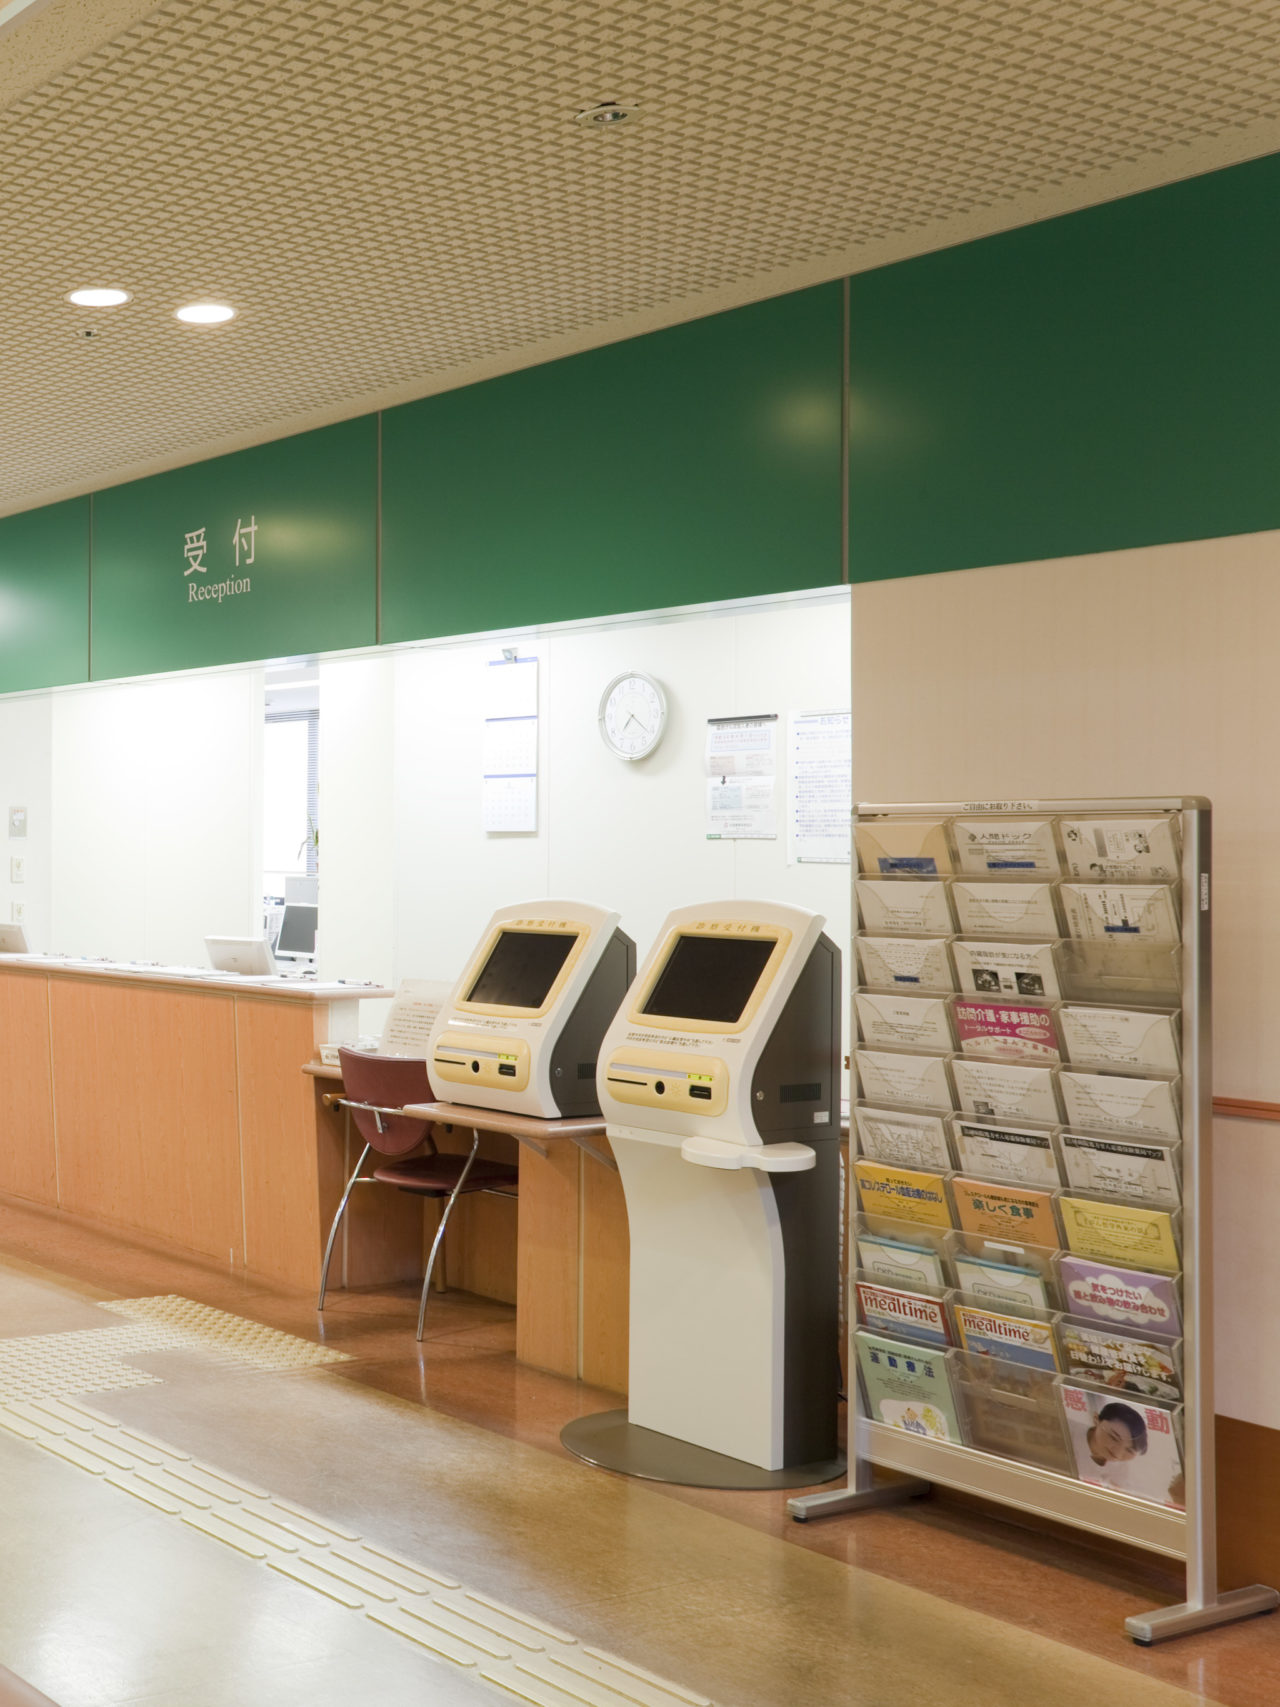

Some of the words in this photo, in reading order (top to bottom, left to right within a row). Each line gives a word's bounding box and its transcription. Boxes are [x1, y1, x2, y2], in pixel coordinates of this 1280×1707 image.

[183, 514, 258, 577] 受付
[188, 573, 251, 603] Reception
[962, 802, 1033, 811] ご自由にお取り下さい。
[980, 832, 1032, 842] 人間ドック
[972, 1198, 1034, 1219] 楽しく食事
[1091, 1282, 1142, 1301] 気をつけたい
[863, 1295, 938, 1323] mealtime
[963, 1316, 1030, 1342] mealtime
